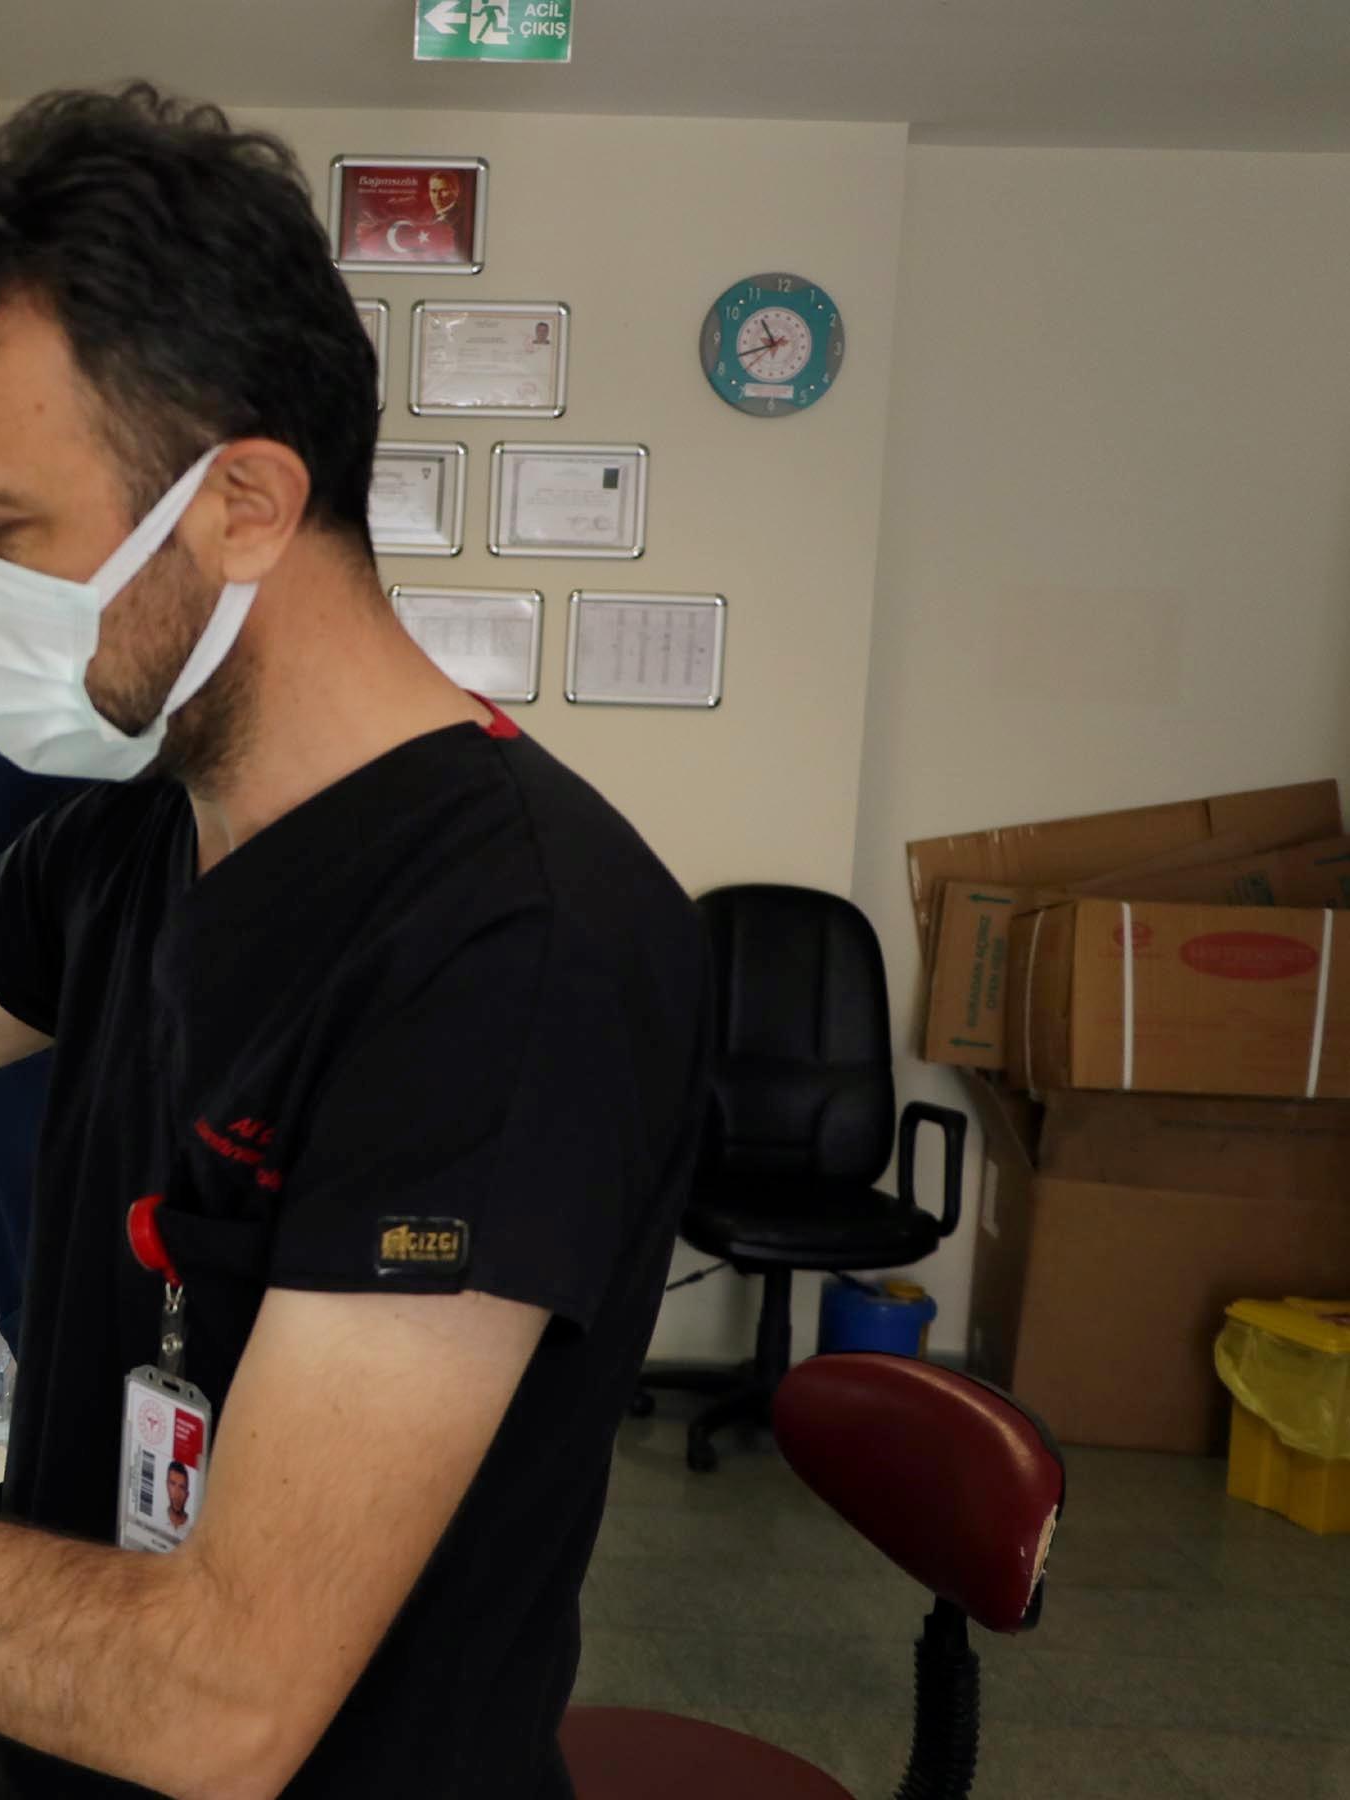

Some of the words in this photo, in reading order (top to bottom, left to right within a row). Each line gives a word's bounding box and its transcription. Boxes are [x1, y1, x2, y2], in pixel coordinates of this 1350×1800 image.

[524, 1, 564, 17] ACİL
[520, 21, 566, 39] ÇIKIŞ
[777, 279, 792, 293] 12
[749, 287, 761, 301] 11
[725, 306, 739, 321] 10
[829, 313, 837, 328] 2
[713, 331, 721, 345] 9
[717, 361, 726, 376] 8
[799, 389, 808, 405] 5
